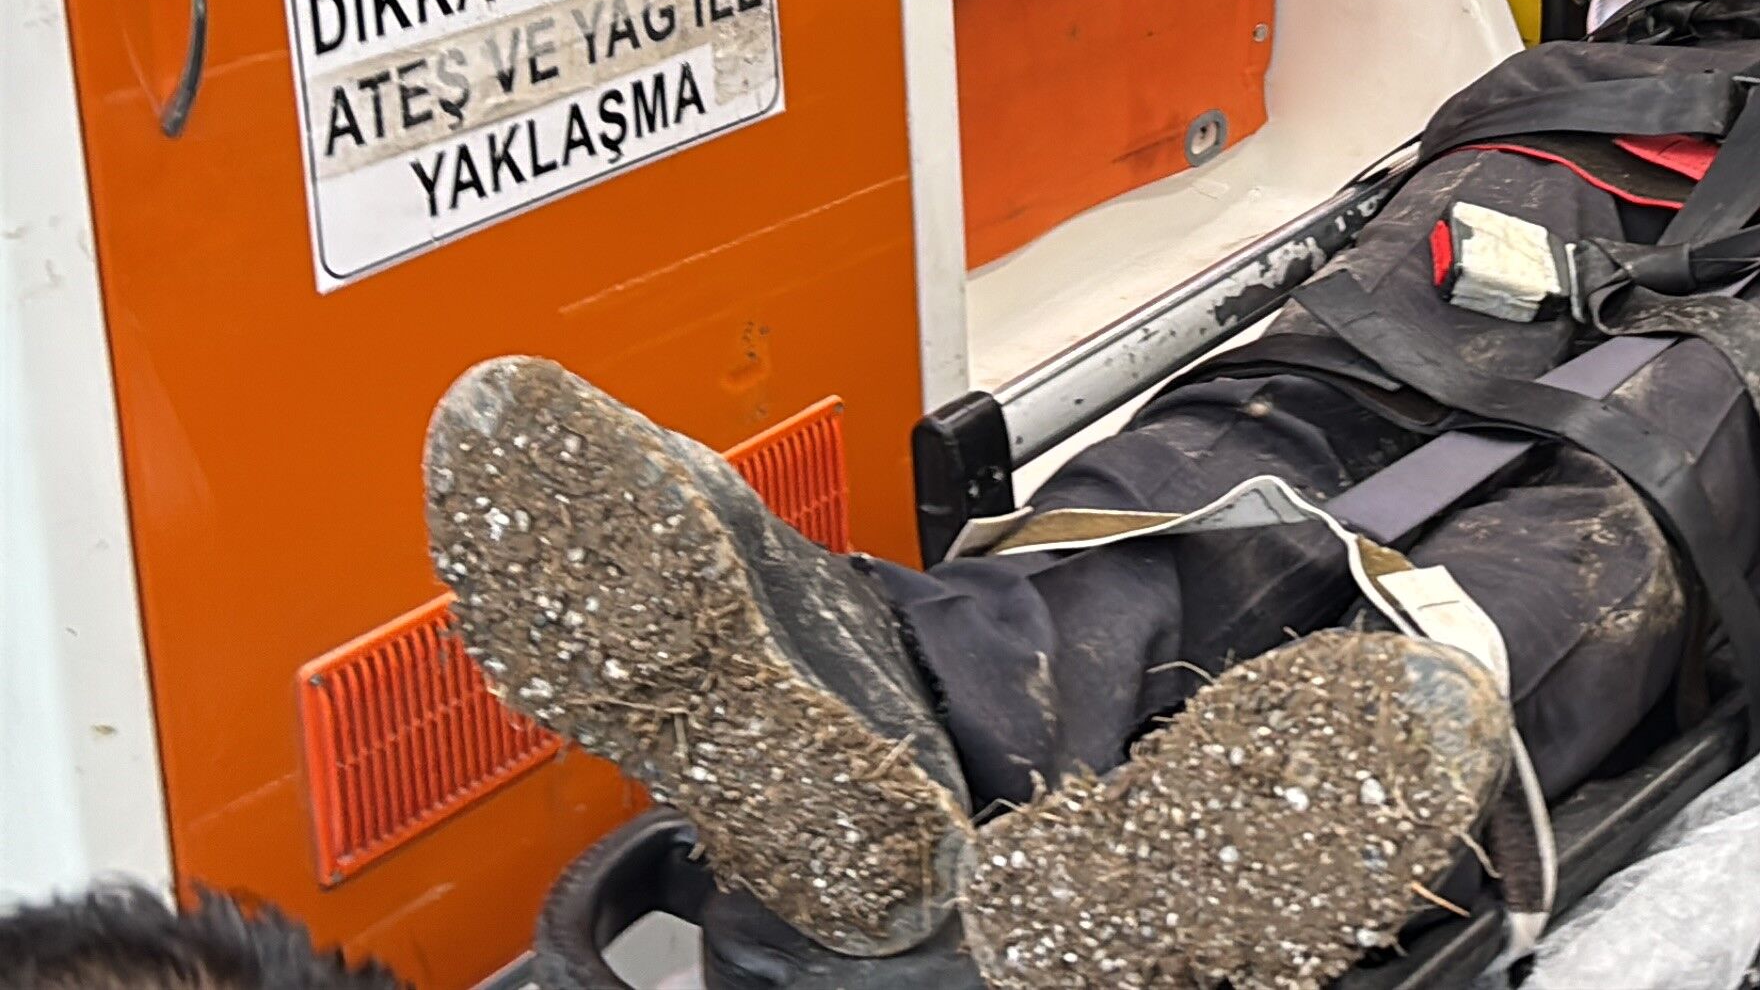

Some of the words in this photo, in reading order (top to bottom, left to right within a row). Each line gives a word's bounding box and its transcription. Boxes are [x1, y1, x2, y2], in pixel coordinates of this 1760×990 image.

[324, 48, 471, 157] ATEŞ
[484, 17, 560, 93] VE
[409, 61, 706, 218] YAKLAŞMA
